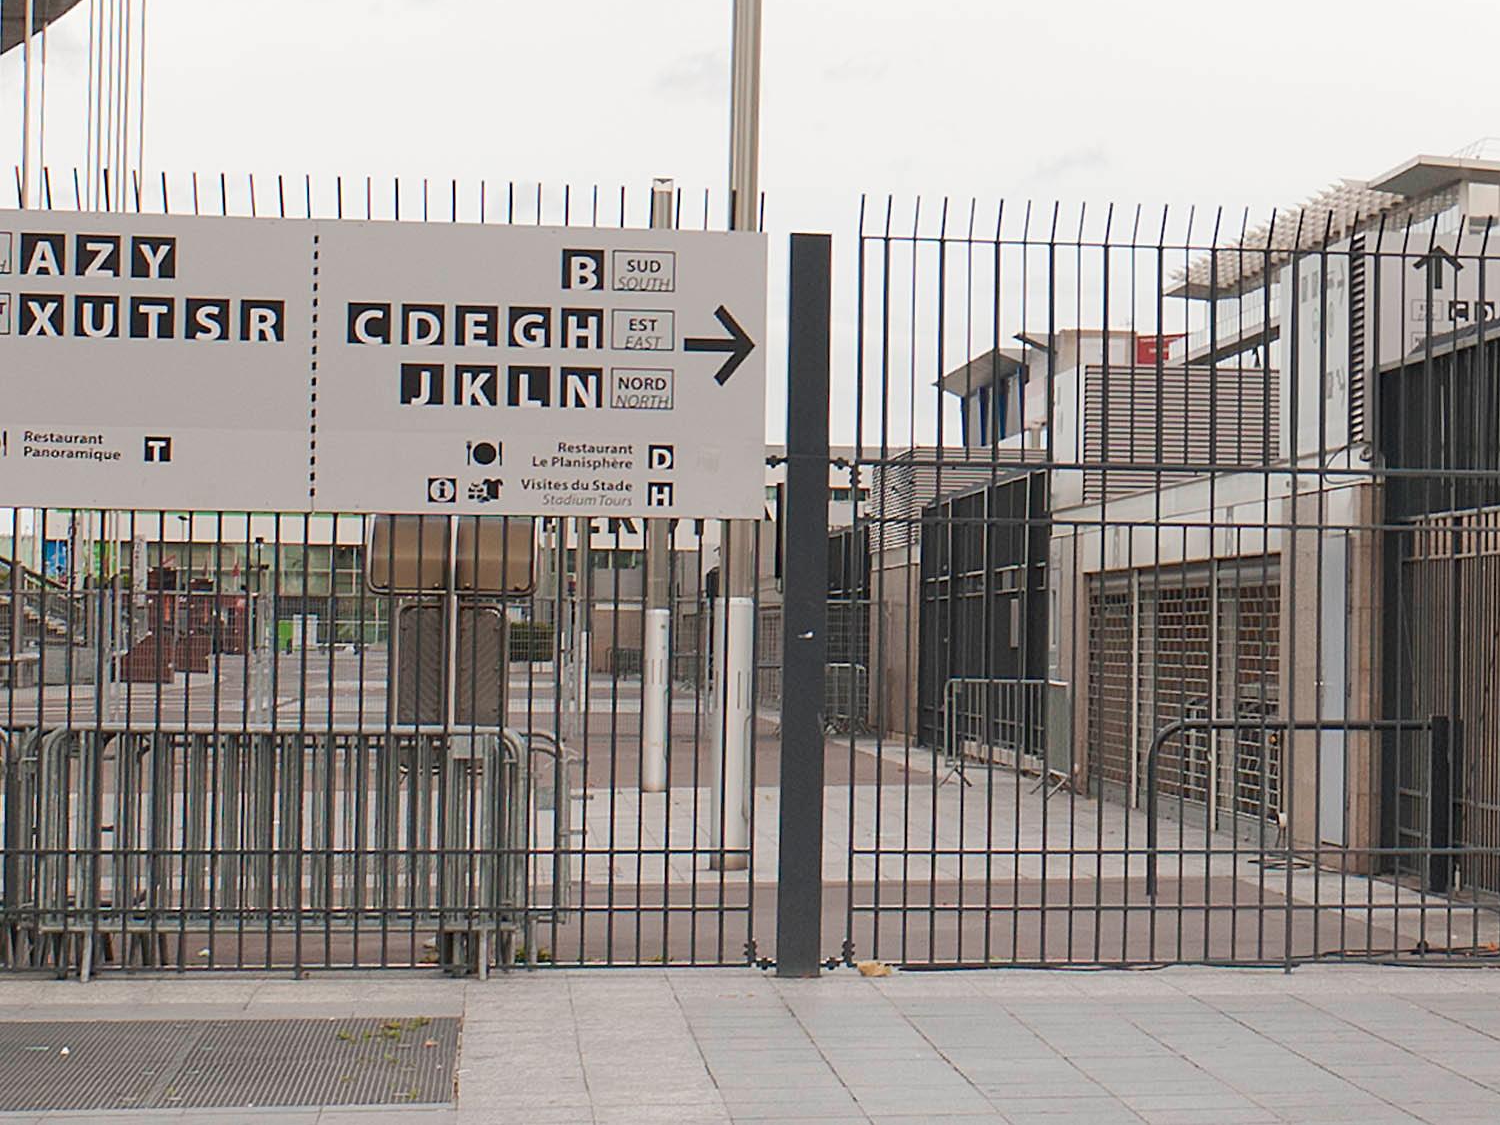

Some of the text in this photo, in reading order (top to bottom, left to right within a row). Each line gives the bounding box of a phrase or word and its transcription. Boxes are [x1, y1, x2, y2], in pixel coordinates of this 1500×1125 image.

[567, 253, 601, 290] B
[626, 259, 661, 273] SUD
[618, 276, 671, 291] SOUTH
[628, 318, 659, 332] EST
[625, 335, 664, 350] EAST
[617, 376, 667, 391] NORD
[615, 394, 671, 410] NORTH
[23, 430, 104, 445] Restaurant
[23, 445, 121, 463] Panoramique
[146, 439, 168, 462] T
[558, 442, 633, 455] Restaurant
[532, 456, 633, 470] Le Planisphère
[650, 447, 673, 470] D
[521, 478, 633, 492] Visites du Stade
[542, 493, 633, 507] Stadium Tours
[650, 484, 671, 507] H
